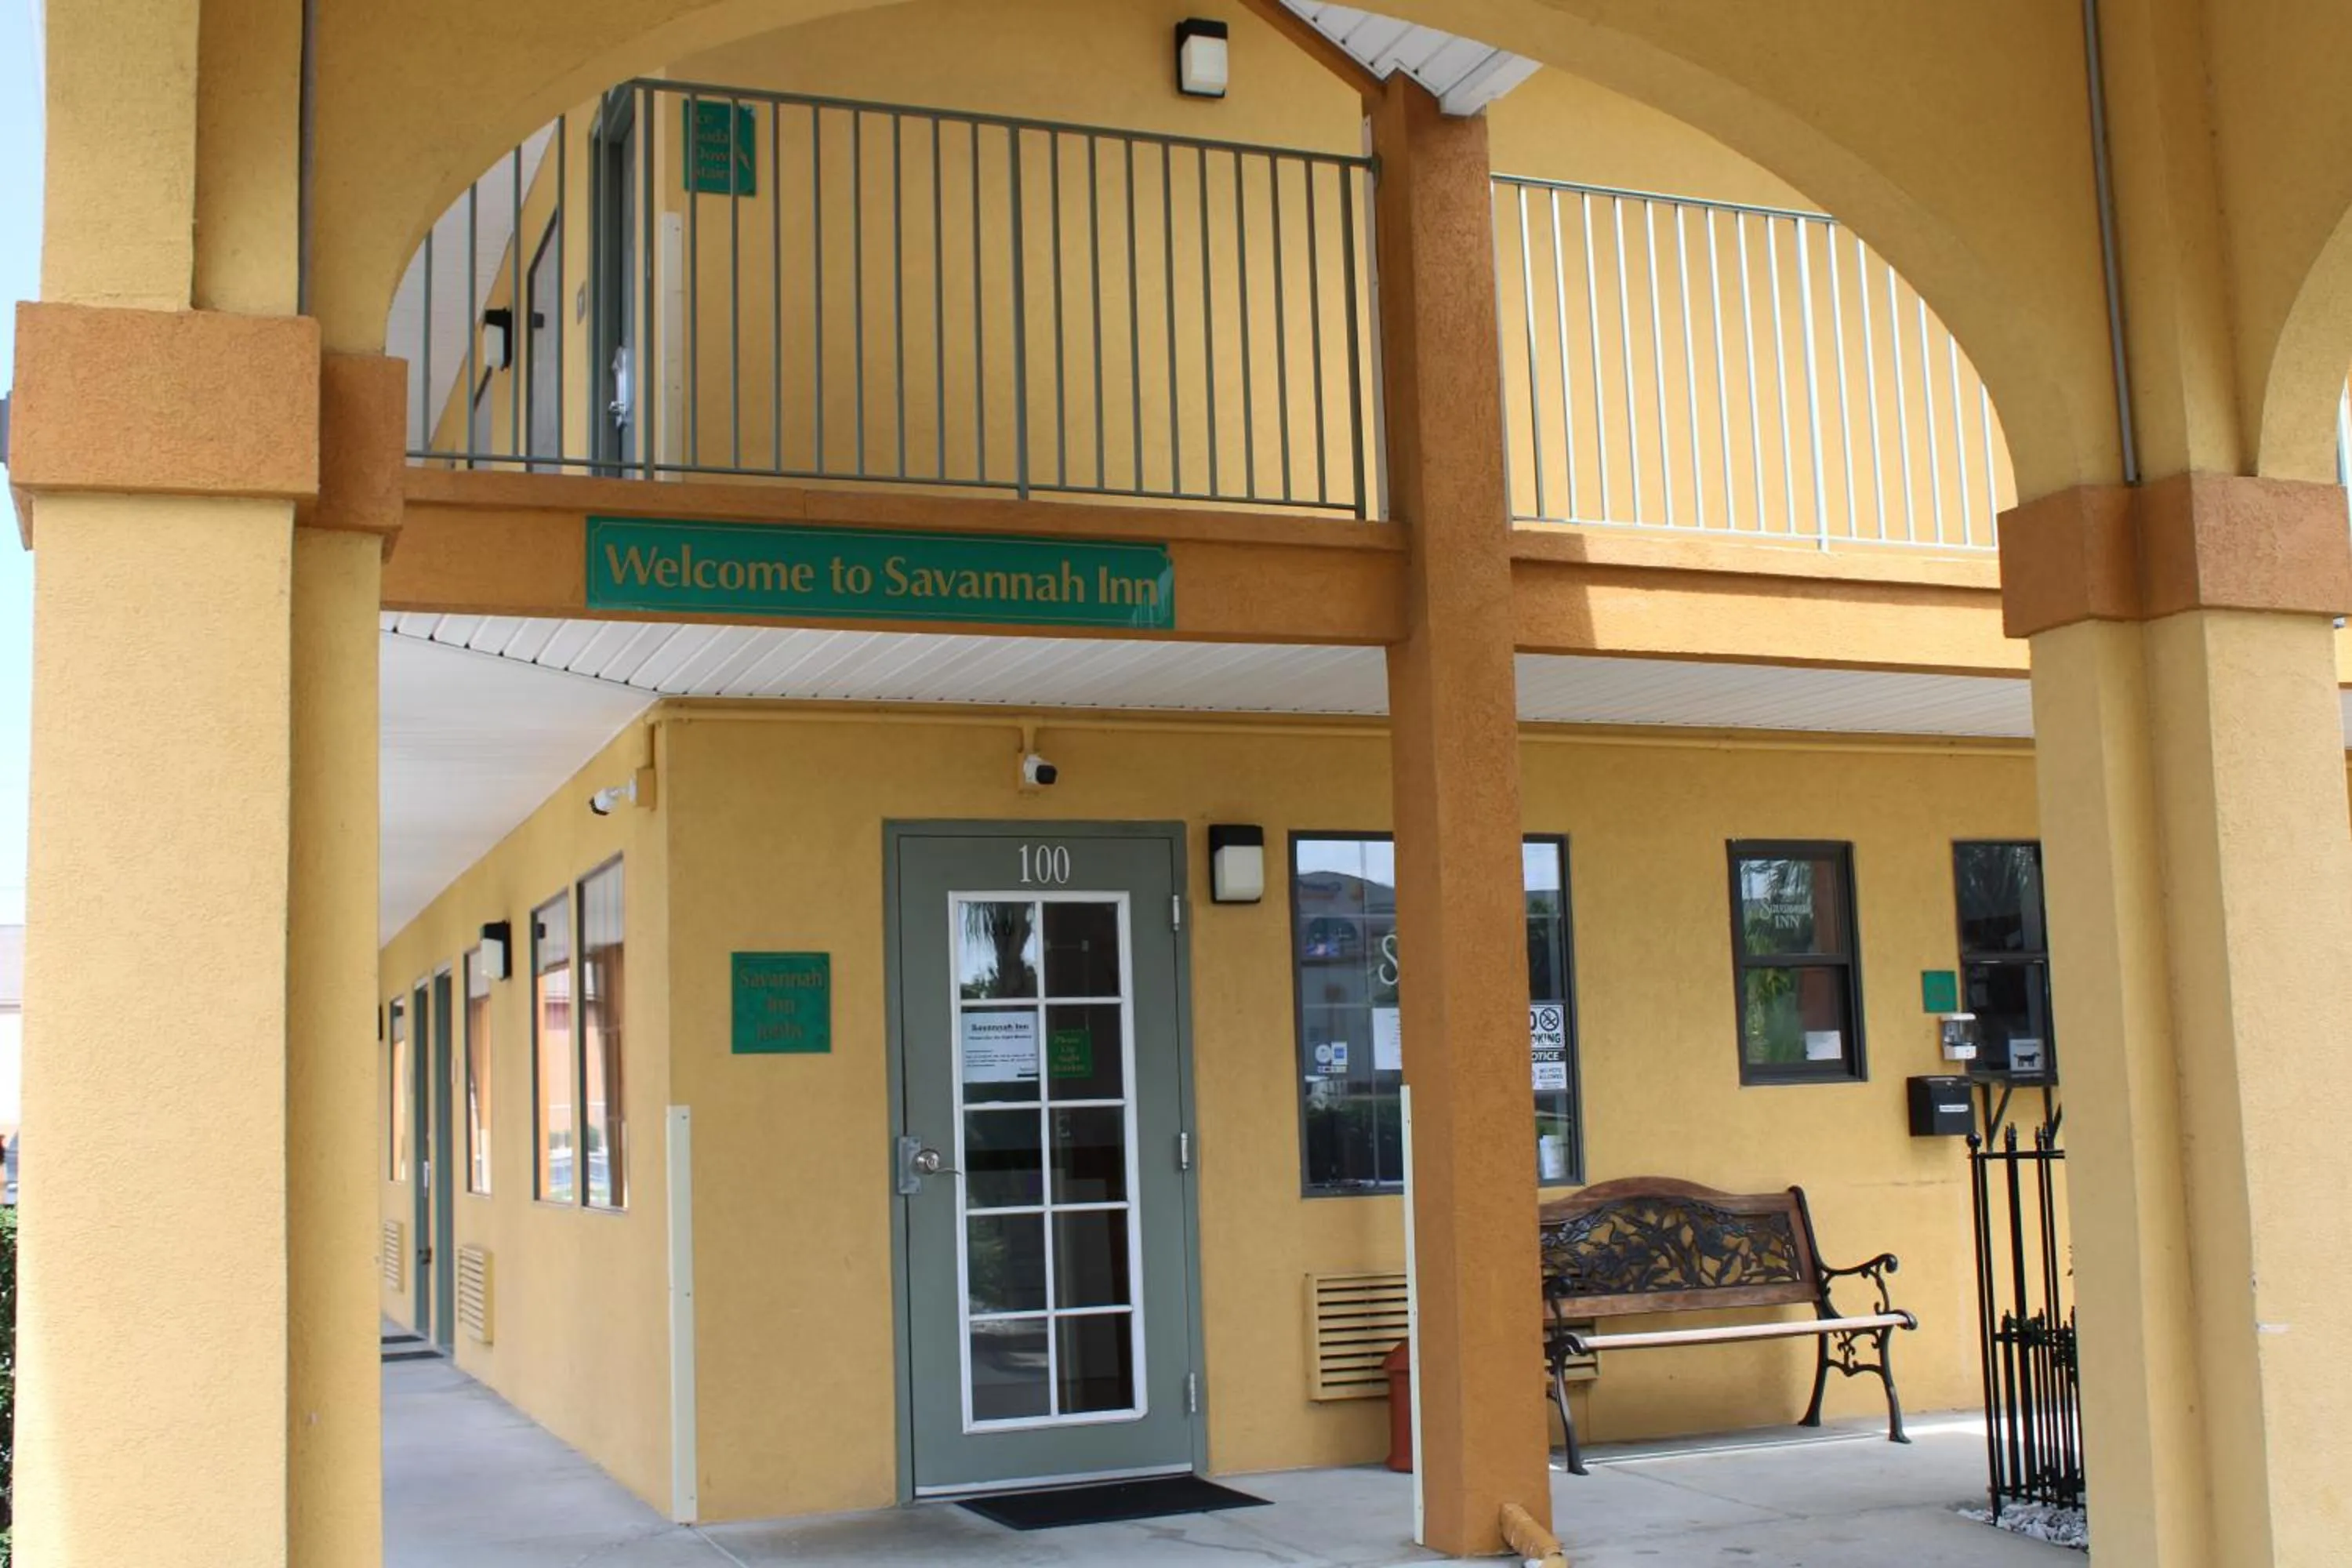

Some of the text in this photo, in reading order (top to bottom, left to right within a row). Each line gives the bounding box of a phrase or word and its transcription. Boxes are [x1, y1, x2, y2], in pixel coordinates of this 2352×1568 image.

[604, 543, 1158, 604] Welcome to Savannah Inn
[1018, 844, 1070, 884] 100
[1775, 915, 1801, 928] INN
[739, 967, 823, 987] Savannah
[766, 996, 795, 1014] Inn
[971, 1023, 1014, 1032] Savannah
[1530, 1033, 1561, 1044] OKING
[1531, 1051, 1559, 1061] OTICE
